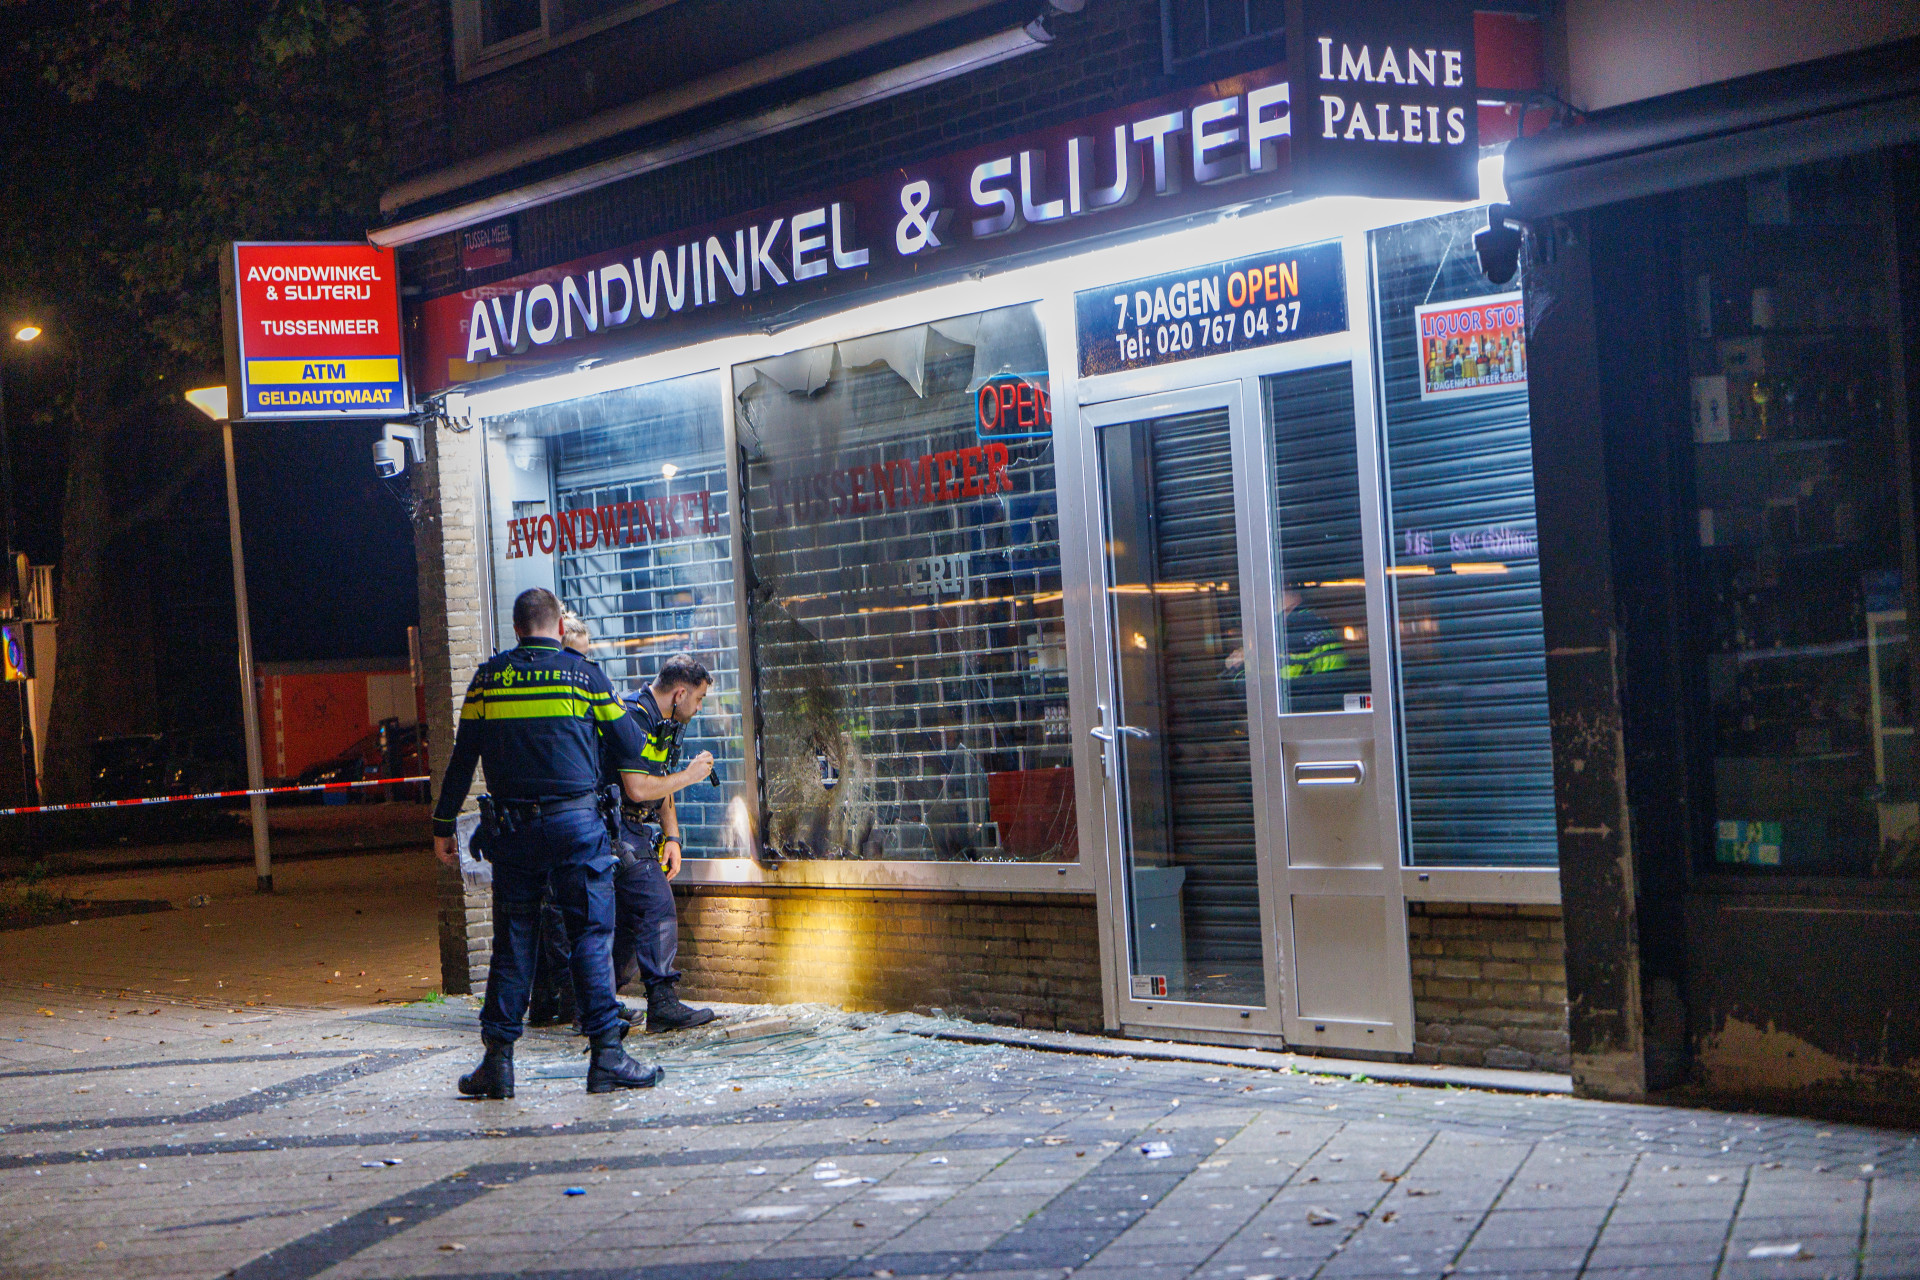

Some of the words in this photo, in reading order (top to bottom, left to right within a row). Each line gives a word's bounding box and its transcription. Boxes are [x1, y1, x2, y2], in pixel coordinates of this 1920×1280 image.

[1318, 38, 1463, 87] IMANE
[1320, 96, 1465, 145] PALEIS
[247, 266, 381, 281] AVONDWINKEL
[266, 286, 278, 300] &
[285, 285, 370, 300] SLIJTERIJ
[467, 203, 869, 362] AVONDWINKEL
[896, 180, 941, 255] &
[1114, 294, 1128, 330] 7
[1135, 275, 1220, 326] DAGEN
[1227, 260, 1298, 308] OPEN
[261, 320, 379, 335] TUSSENMEER
[1116, 329, 1150, 361] Tel:
[1157, 321, 1193, 354] 020
[1199, 313, 1236, 346] 767
[1243, 307, 1269, 338] 04
[1276, 301, 1300, 333] 37
[1422, 310, 1482, 339] LIQUOR
[302, 363, 346, 380] ATM
[1427, 382, 1432, 392] 7
[1434, 378, 1461, 391] DAGEN
[1463, 376, 1477, 387] PER
[1479, 374, 1500, 385] WEEK
[258, 389, 392, 405] GELDAUTOMAAT
[979, 381, 1052, 430] OPEN
[769, 442, 1013, 525] TUSSENMEER
[505, 490, 719, 559] AVONDWINKEL
